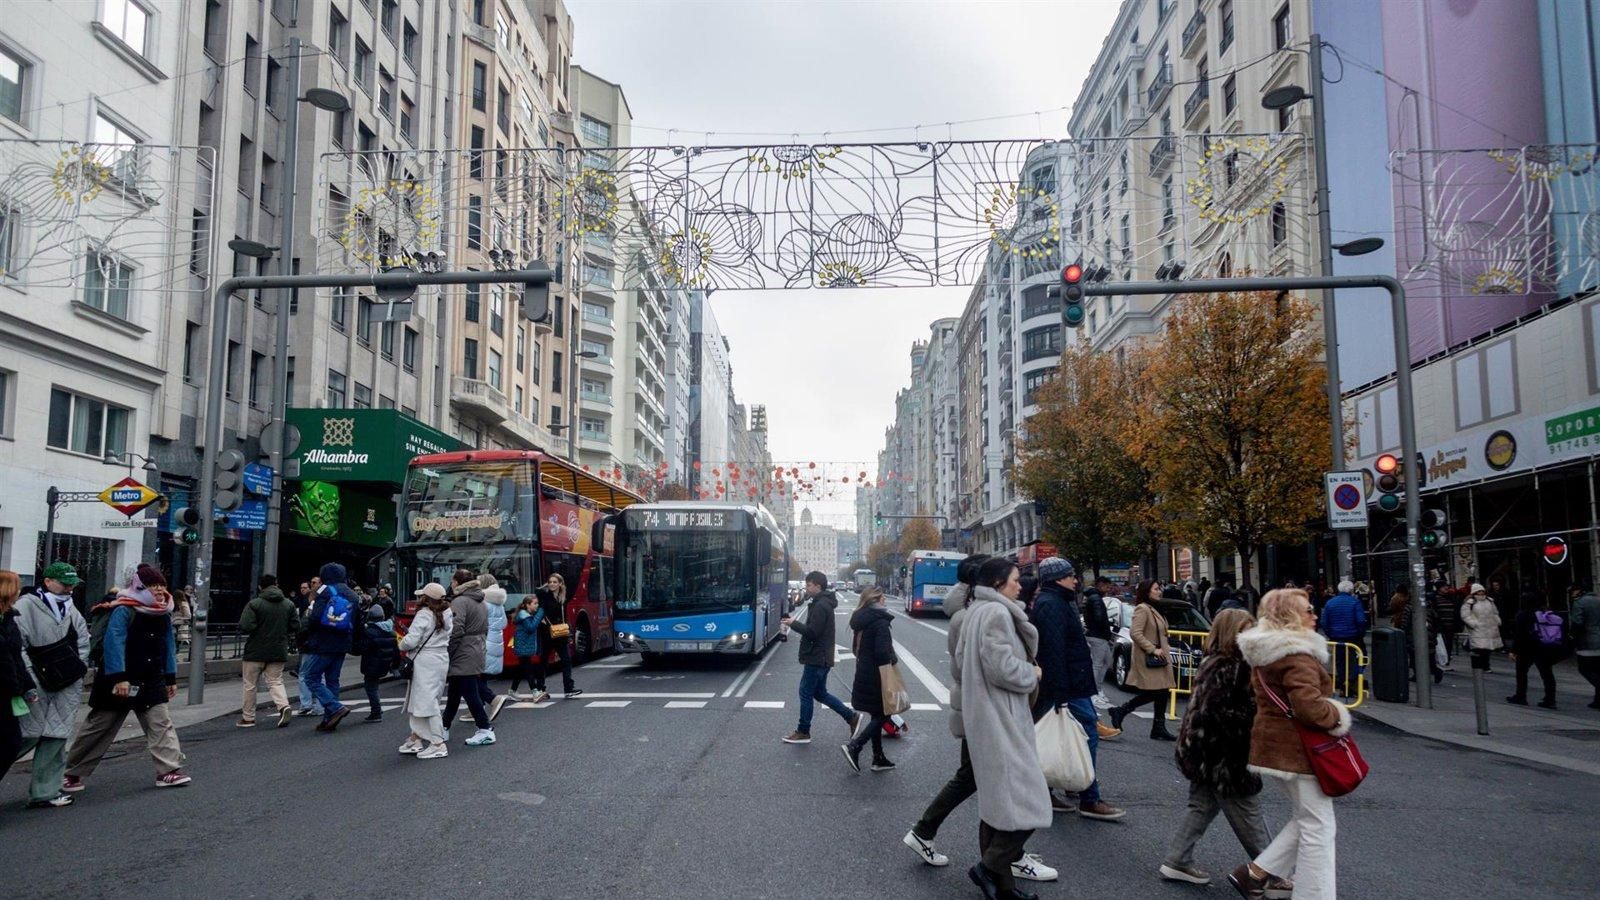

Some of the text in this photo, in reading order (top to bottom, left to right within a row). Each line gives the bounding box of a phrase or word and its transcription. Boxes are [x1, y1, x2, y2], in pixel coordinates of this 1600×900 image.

[1547, 414, 1600, 438] SOPOR
[410, 434, 422, 445] HAY
[1566, 437, 1589, 451] 748
[405, 442, 416, 453] SIN
[302, 449, 369, 465] Alhambra
[113, 491, 140, 500] Metro
[131, 520, 153, 528] España
[643, 511, 660, 527] 74
[641, 624, 659, 632] 3264
